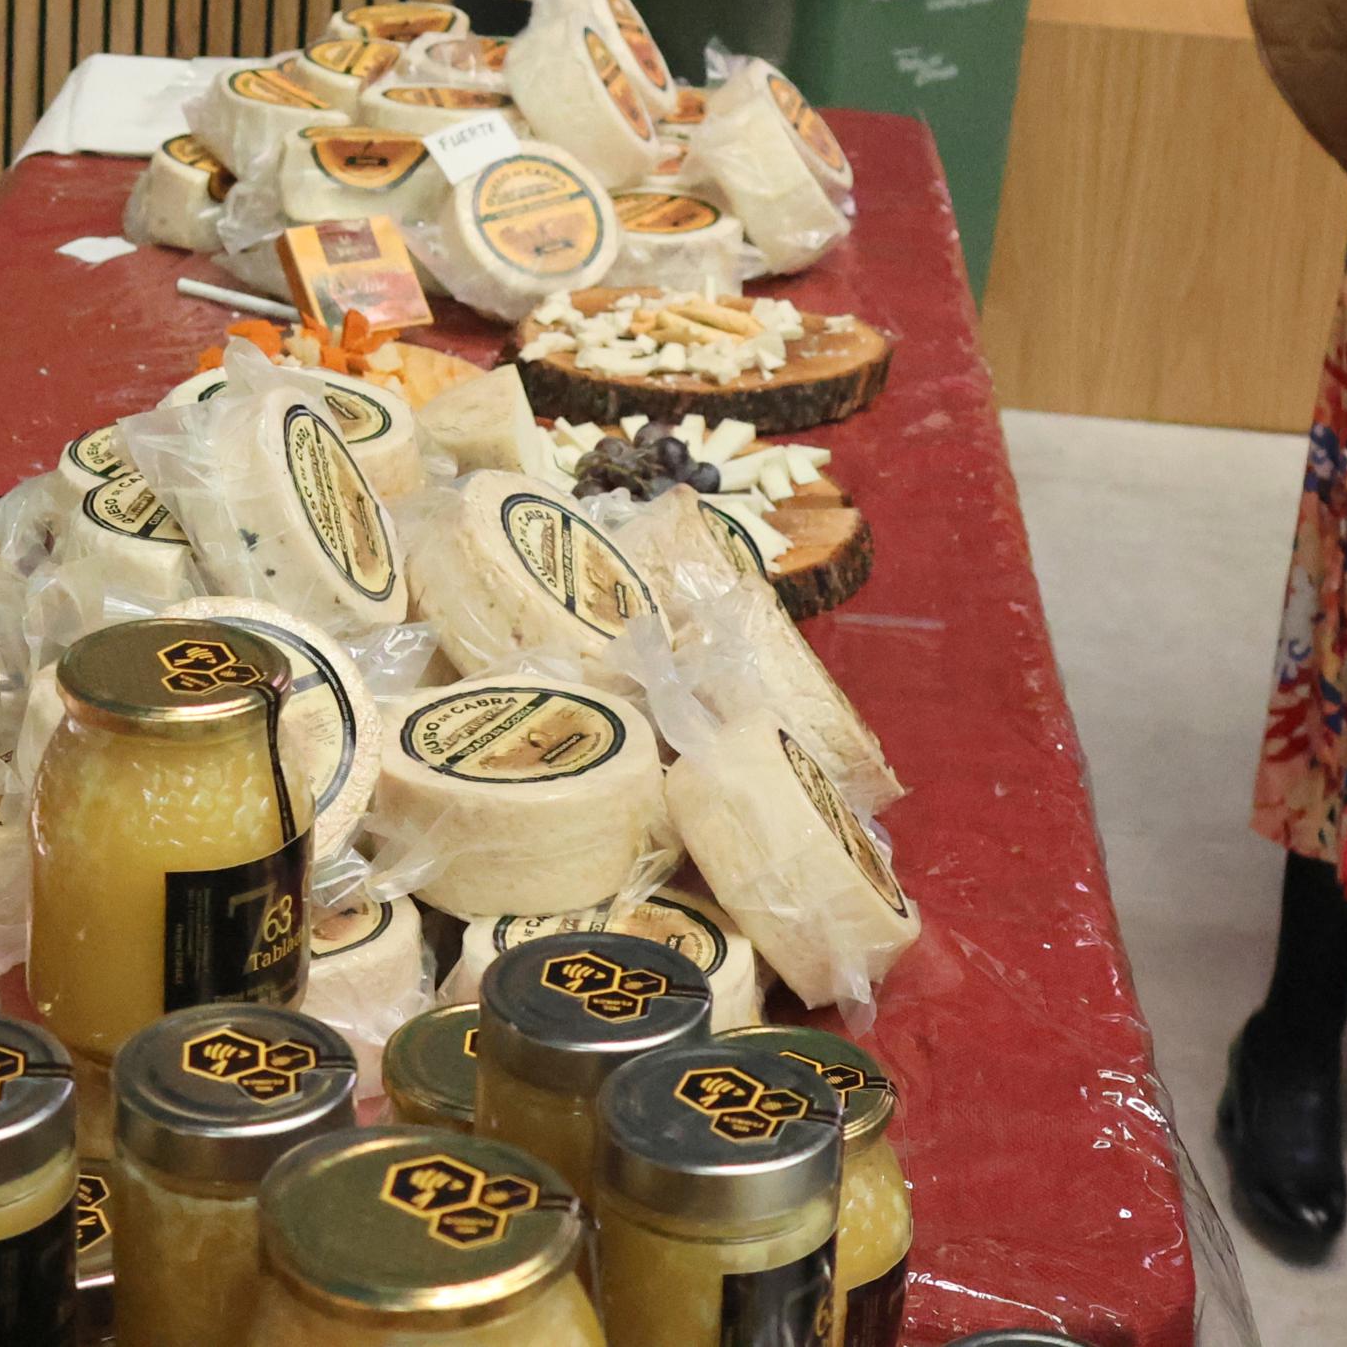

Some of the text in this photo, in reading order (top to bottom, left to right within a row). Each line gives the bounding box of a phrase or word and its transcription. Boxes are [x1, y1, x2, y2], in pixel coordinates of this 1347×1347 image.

[104, 497, 136, 525] QUESO
[449, 696, 519, 714] CABRA
[263, 894, 293, 943] 63
